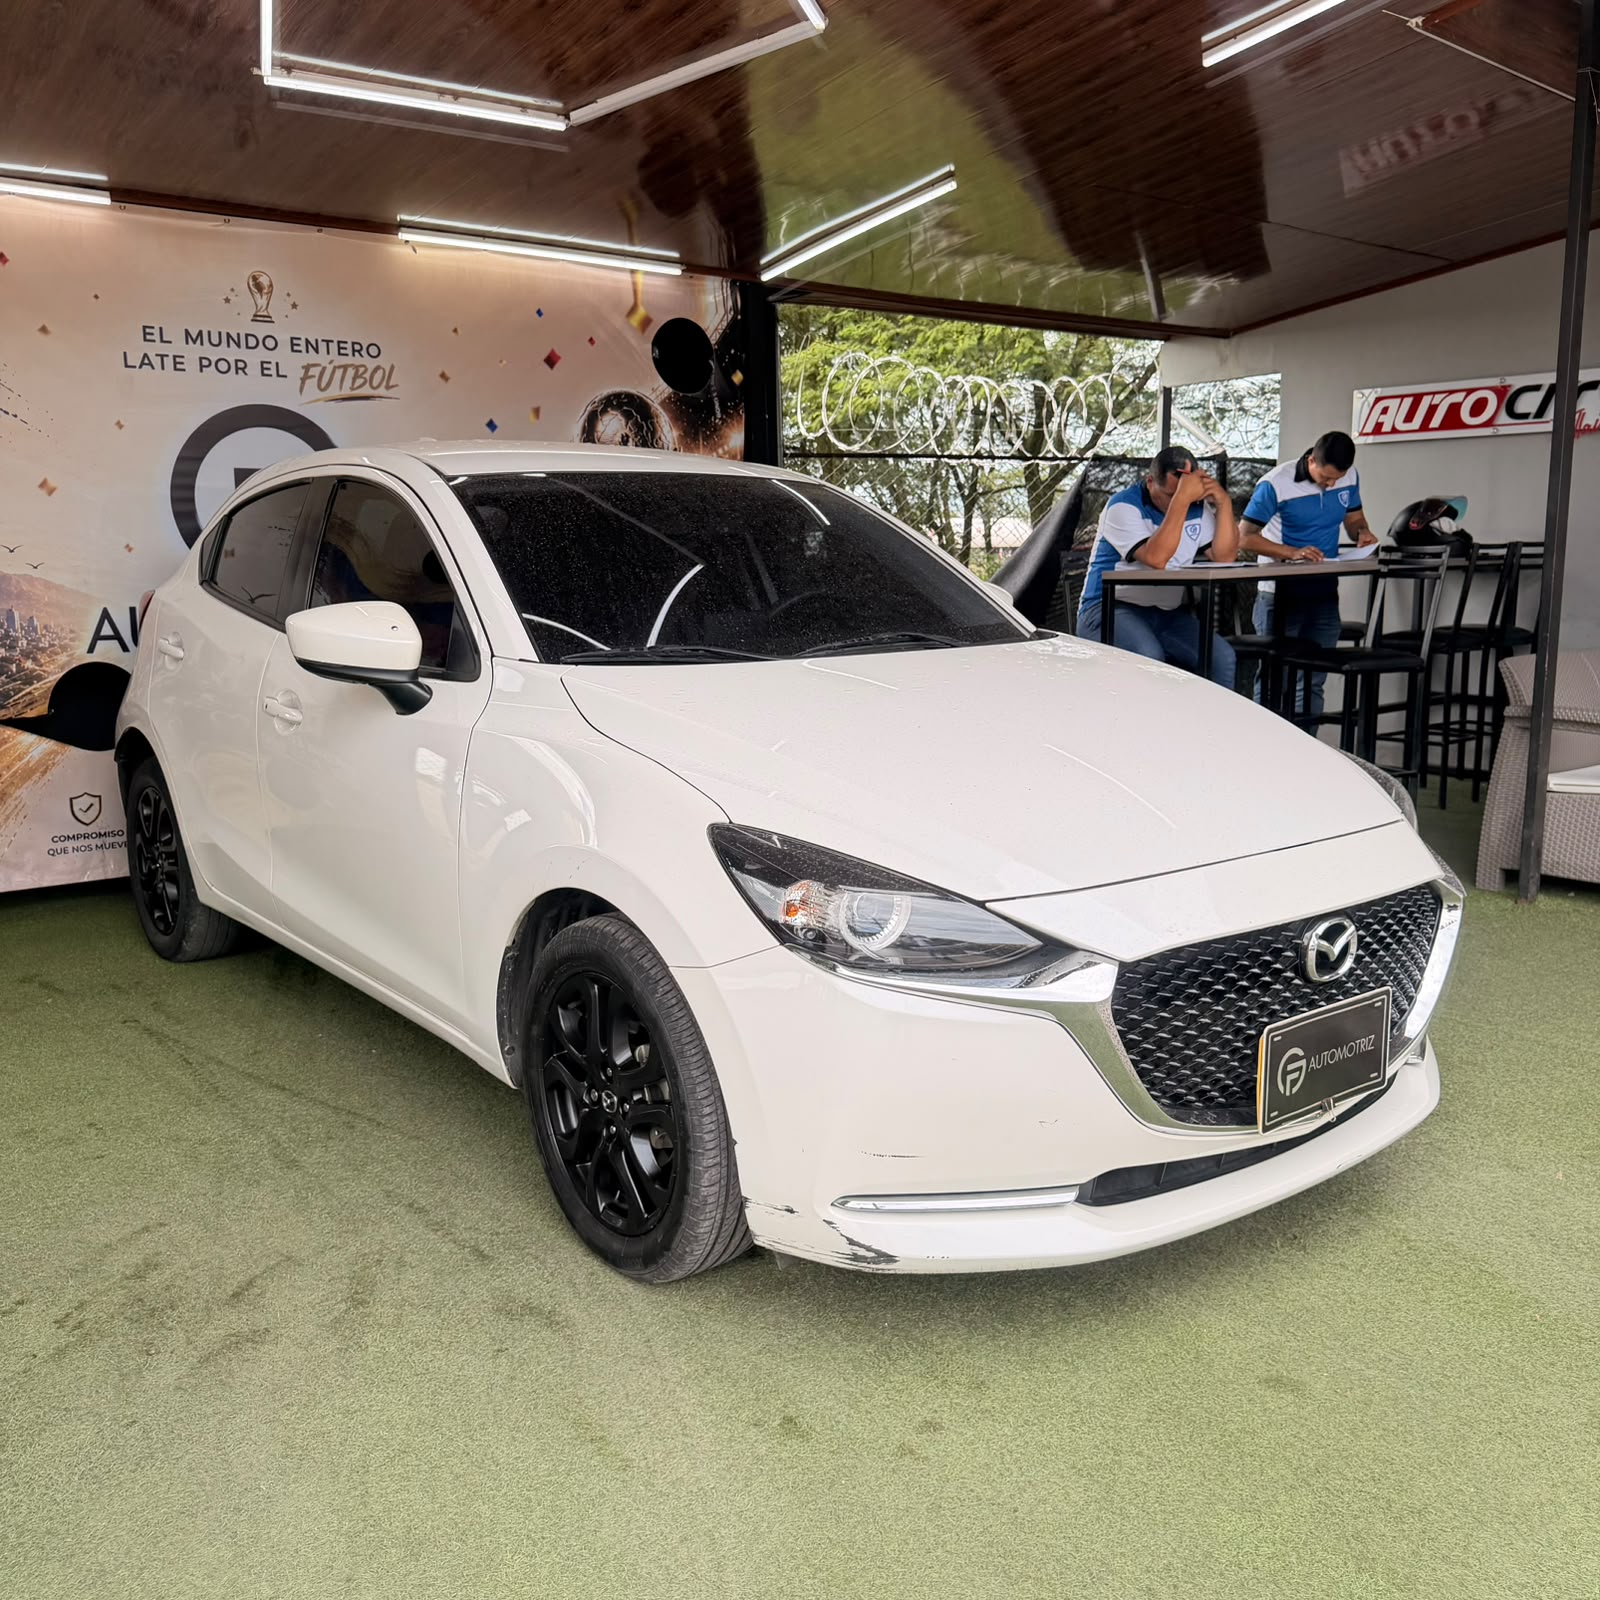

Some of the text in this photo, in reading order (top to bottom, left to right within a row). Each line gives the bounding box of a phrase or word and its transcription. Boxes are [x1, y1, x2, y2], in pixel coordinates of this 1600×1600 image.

[142, 325, 382, 359] EL MUNDO ENTERO
[123, 351, 400, 396] LATE POR EL FÚTBOL
[47, 846, 69, 857] QUE
[72, 844, 93, 854] NOS
[51, 829, 125, 843] COMPROMISO
[1308, 1034, 1376, 1072] AUTOMOTRIZ
